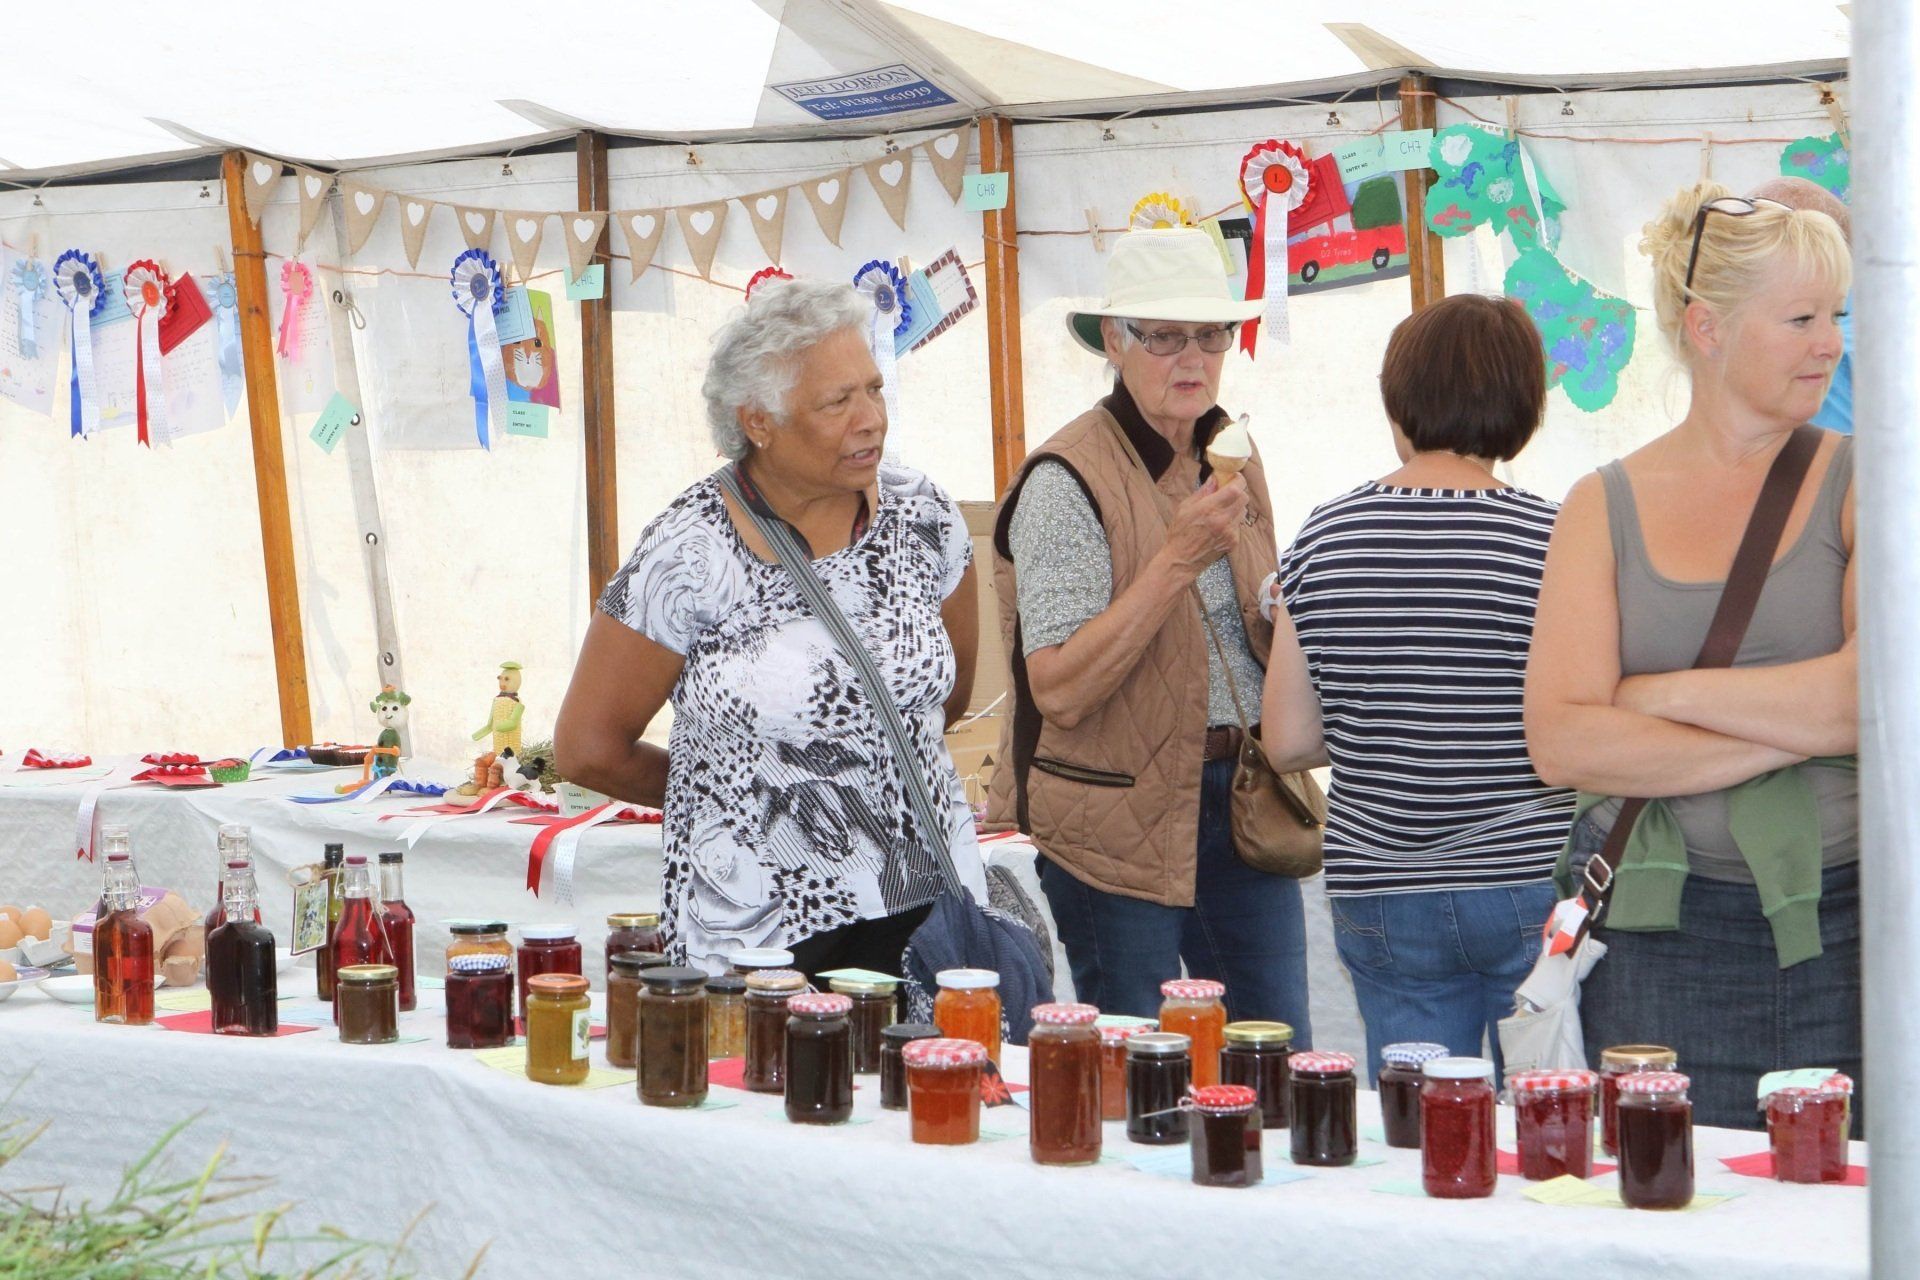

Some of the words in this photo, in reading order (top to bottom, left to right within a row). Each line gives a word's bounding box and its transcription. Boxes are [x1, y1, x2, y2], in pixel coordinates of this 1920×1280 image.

[785, 82, 831, 98] JEFF
[829, 69, 910, 91] DOBSON
[807, 100, 841, 112] Tel:
[839, 96, 882, 107] 01388
[883, 86, 932, 102] 661919
[1400, 140, 1422, 155] CH7
[1342, 151, 1357, 160] CLASS
[1345, 164, 1360, 174] ENTRY
[976, 183, 996, 198] CH8
